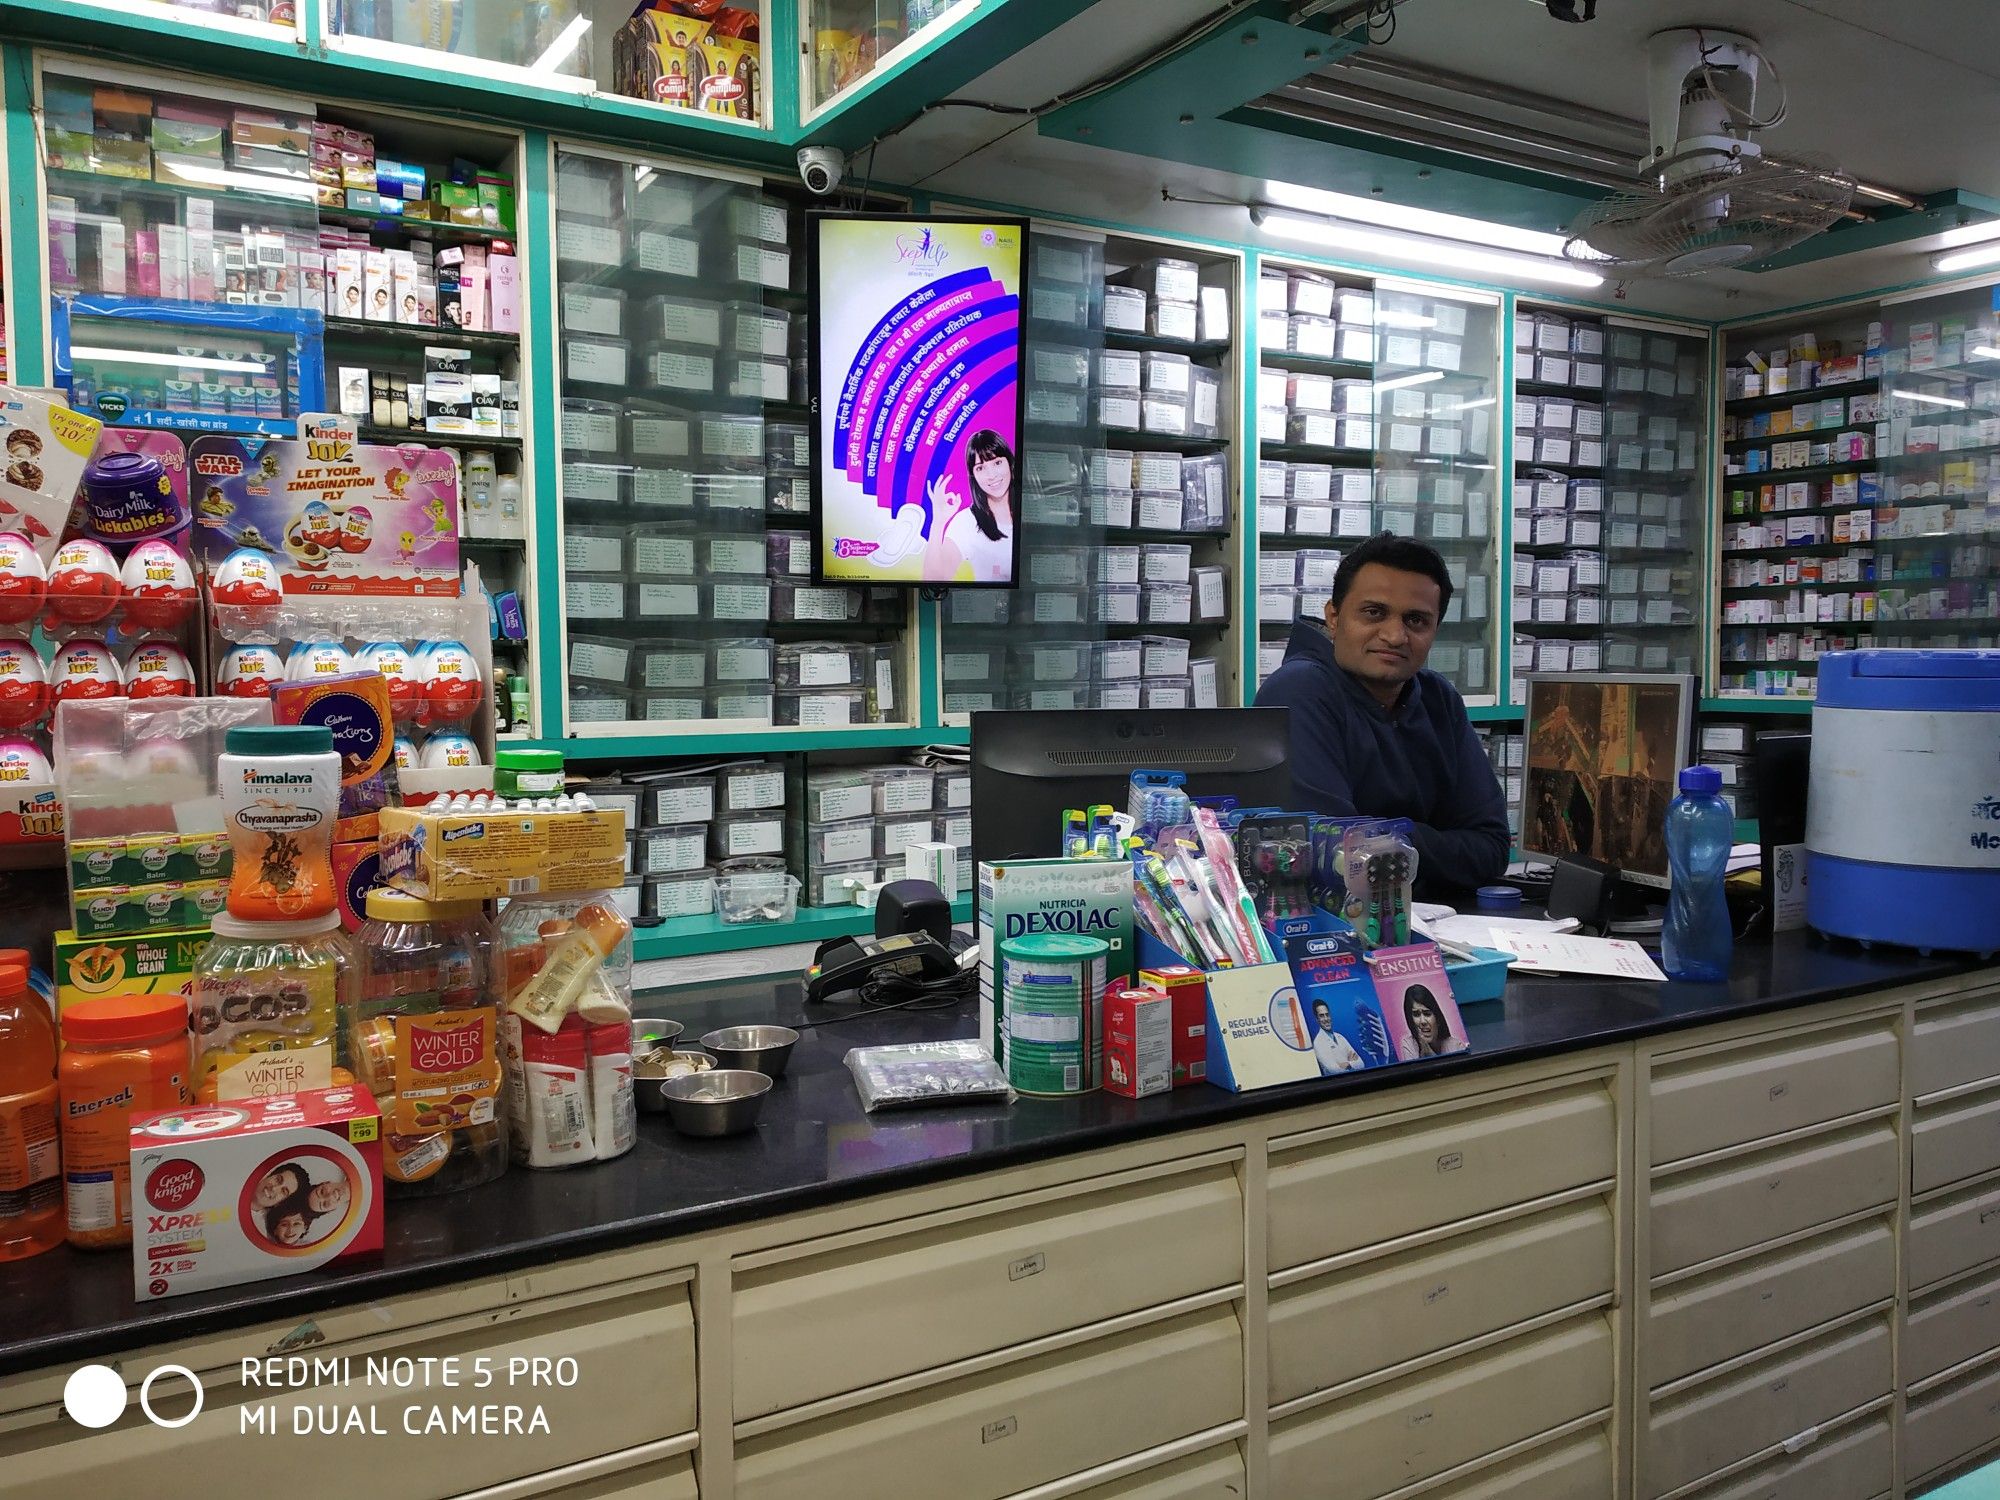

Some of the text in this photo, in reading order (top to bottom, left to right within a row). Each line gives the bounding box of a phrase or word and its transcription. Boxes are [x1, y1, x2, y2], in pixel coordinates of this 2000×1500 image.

[658, 83, 686, 97] Compl
[705, 83, 741, 98] Complan
[99, 403, 125, 411] VICKS
[52, 412, 97, 433] Try one at
[200, 419, 211, 428] का
[212, 420, 228, 429] ब्रांड
[196, 455, 242, 465] STAR
[196, 464, 242, 475] WARS
[297, 466, 361, 479] LET YOUR
[287, 477, 375, 492] IMAGINATION
[322, 490, 344, 501] FLY
[95, 499, 152, 518] Dairy Milk
[243, 768, 312, 784] Himalaya
[240, 812, 317, 826] Chyavanaprasha
[445, 824, 481, 840] Alpenliebe
[144, 855, 167, 864] ZANDU
[197, 852, 220, 860] ZANDU
[89, 859, 113, 867] ZANDU
[91, 875, 111, 883] Balm
[146, 871, 166, 879] Balm
[146, 901, 170, 909] ZANDU
[200, 897, 223, 906] ZANDU
[1040, 899, 1086, 910] NUTRICIA
[94, 922, 114, 930] Balm
[149, 917, 169, 925] Balm
[1005, 908, 1120, 938] DEXOLAC
[1285, 923, 1308, 934] Oral-B
[1309, 941, 1336, 952] Oral-B
[136, 949, 168, 961] WHOLE
[136, 961, 165, 974] GRAIN
[1300, 954, 1356, 972] ADVANCED
[1380, 954, 1443, 976] ENSITIVE
[1314, 968, 1350, 983] CLEAN
[1228, 1016, 1268, 1029] REGULAR
[1232, 1026, 1270, 1039] BRUSHES
[414, 1030, 480, 1050] WINTER
[419, 1047, 474, 1068] GOLD
[245, 1065, 305, 1083] WINTER
[251, 1081, 298, 1096] GOLD
[160, 1169, 193, 1187] Good
[154, 1179, 196, 1203] knight
[147, 1229, 203, 1246] SYSTEM
